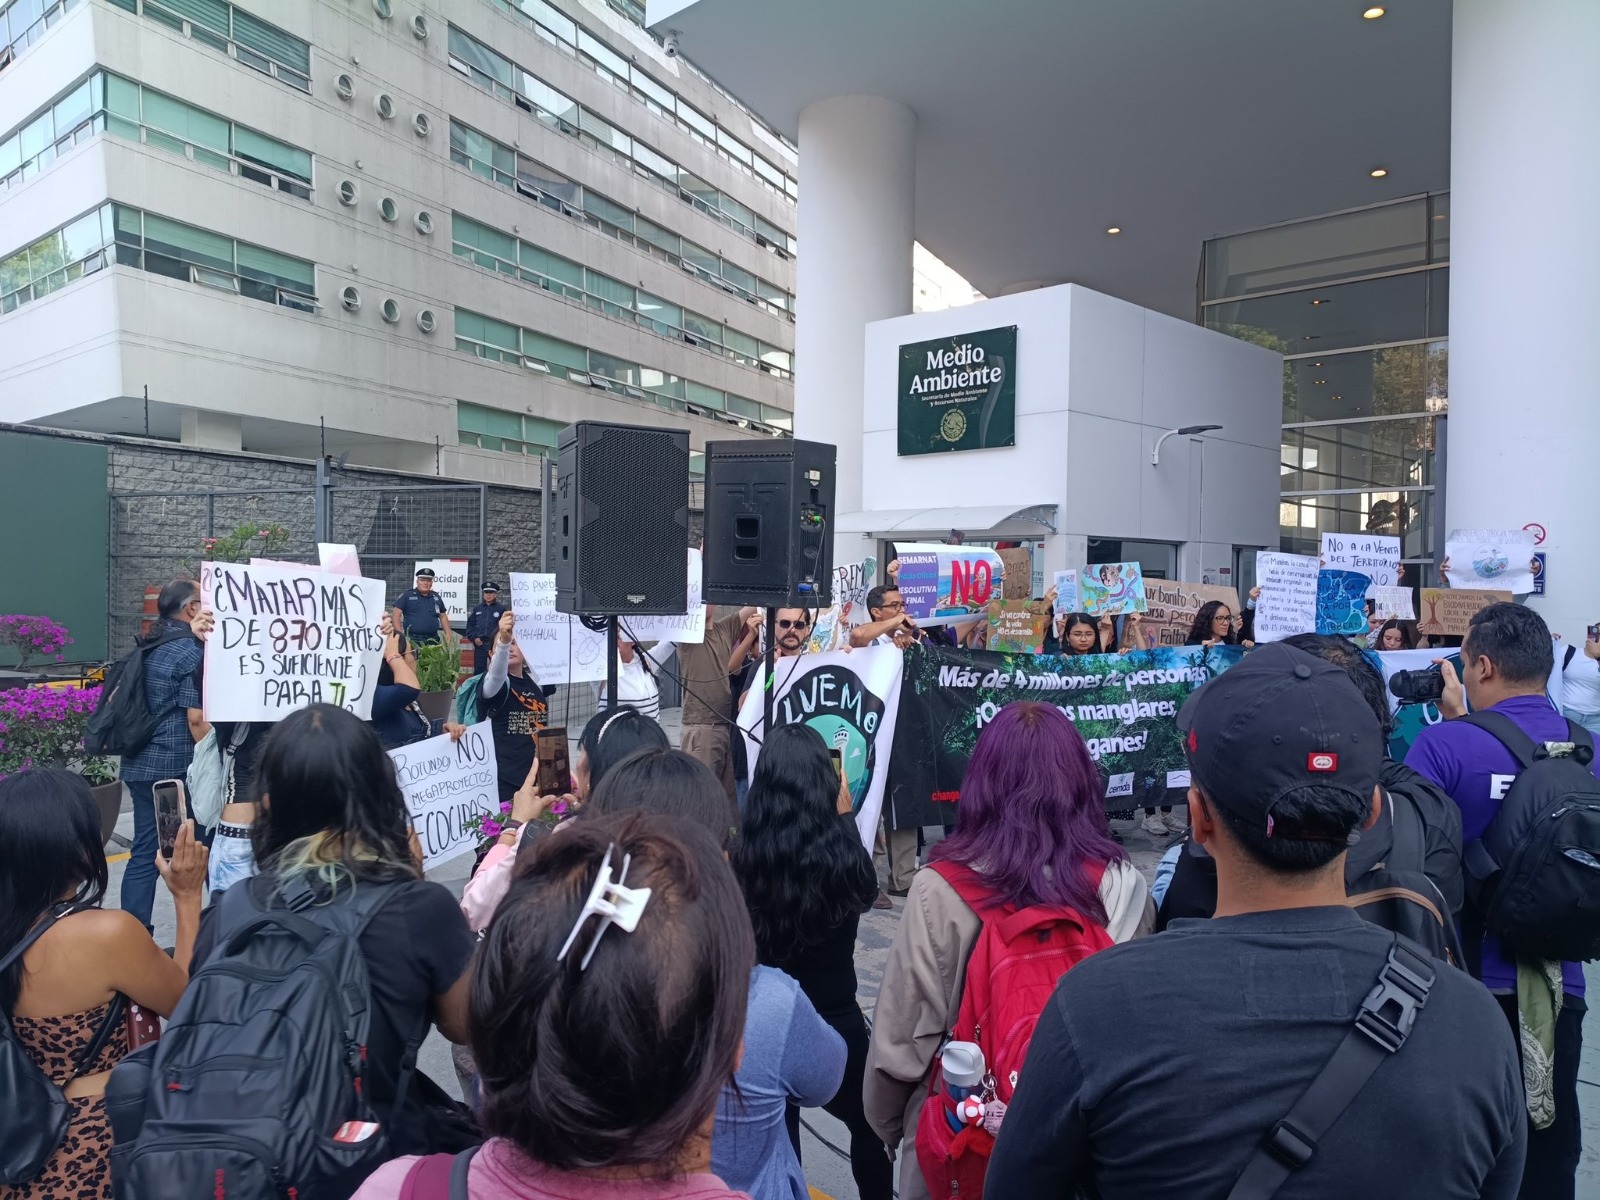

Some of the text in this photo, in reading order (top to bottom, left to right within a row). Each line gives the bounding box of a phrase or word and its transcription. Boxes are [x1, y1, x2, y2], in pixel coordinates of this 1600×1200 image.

[926, 343, 984, 371] Medio
[909, 366, 1002, 395] Ambiente
[1328, 538, 1344, 553] NO
[1350, 543, 1357, 551] A
[1373, 540, 1399, 555] VENTA
[897, 555, 937, 565] SEMARNAT
[1330, 555, 1398, 570] DEL TERRITORIO
[433, 574, 464, 584] ocidad
[532, 578, 557, 593] pueb
[950, 559, 992, 606] NO
[1370, 571, 1389, 586] NO
[906, 596, 926, 605] FINAL
[1158, 585, 1187, 608] bonito
[447, 605, 466, 616] /hr.
[629, 615, 655, 631] ENCIA
[221, 616, 384, 654] DE 870 ESPECIES
[239, 652, 353, 680] ES SUFICIENTE
[938, 665, 1207, 692] Más de 4 millones de personas
[263, 678, 323, 708] PARA
[1077, 698, 1178, 725] manglares,
[456, 730, 486, 764] NO
[1085, 731, 1148, 761] ganes!
[411, 769, 494, 806] MEGAPROYECTOS
[931, 790, 961, 803] change
